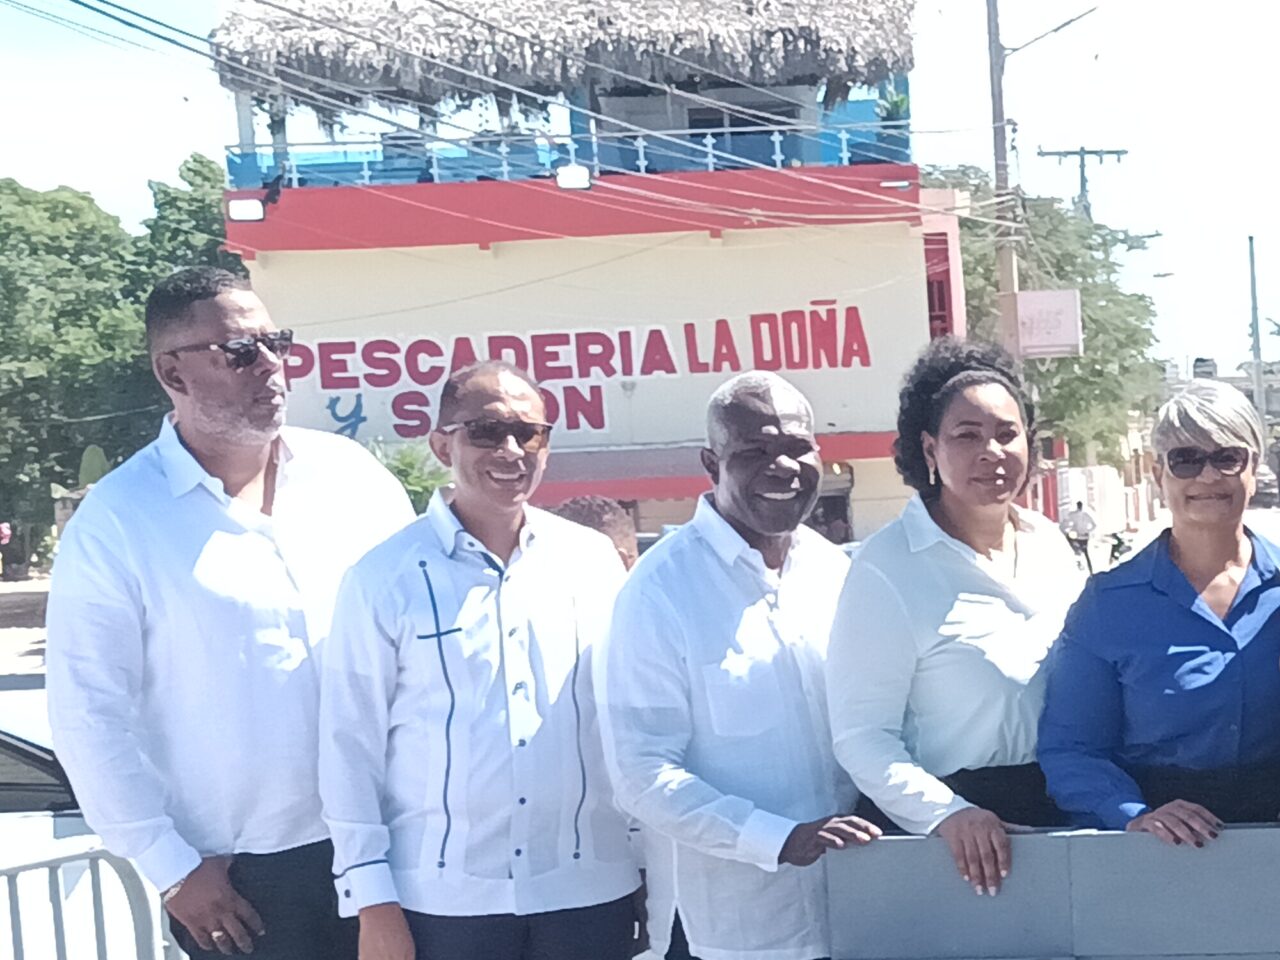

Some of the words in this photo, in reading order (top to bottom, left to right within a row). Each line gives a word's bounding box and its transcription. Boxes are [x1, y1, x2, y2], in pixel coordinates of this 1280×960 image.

[283, 328, 677, 392] PESCADERIA
[683, 318, 741, 374] LA
[750, 299, 871, 371] DOÑA
